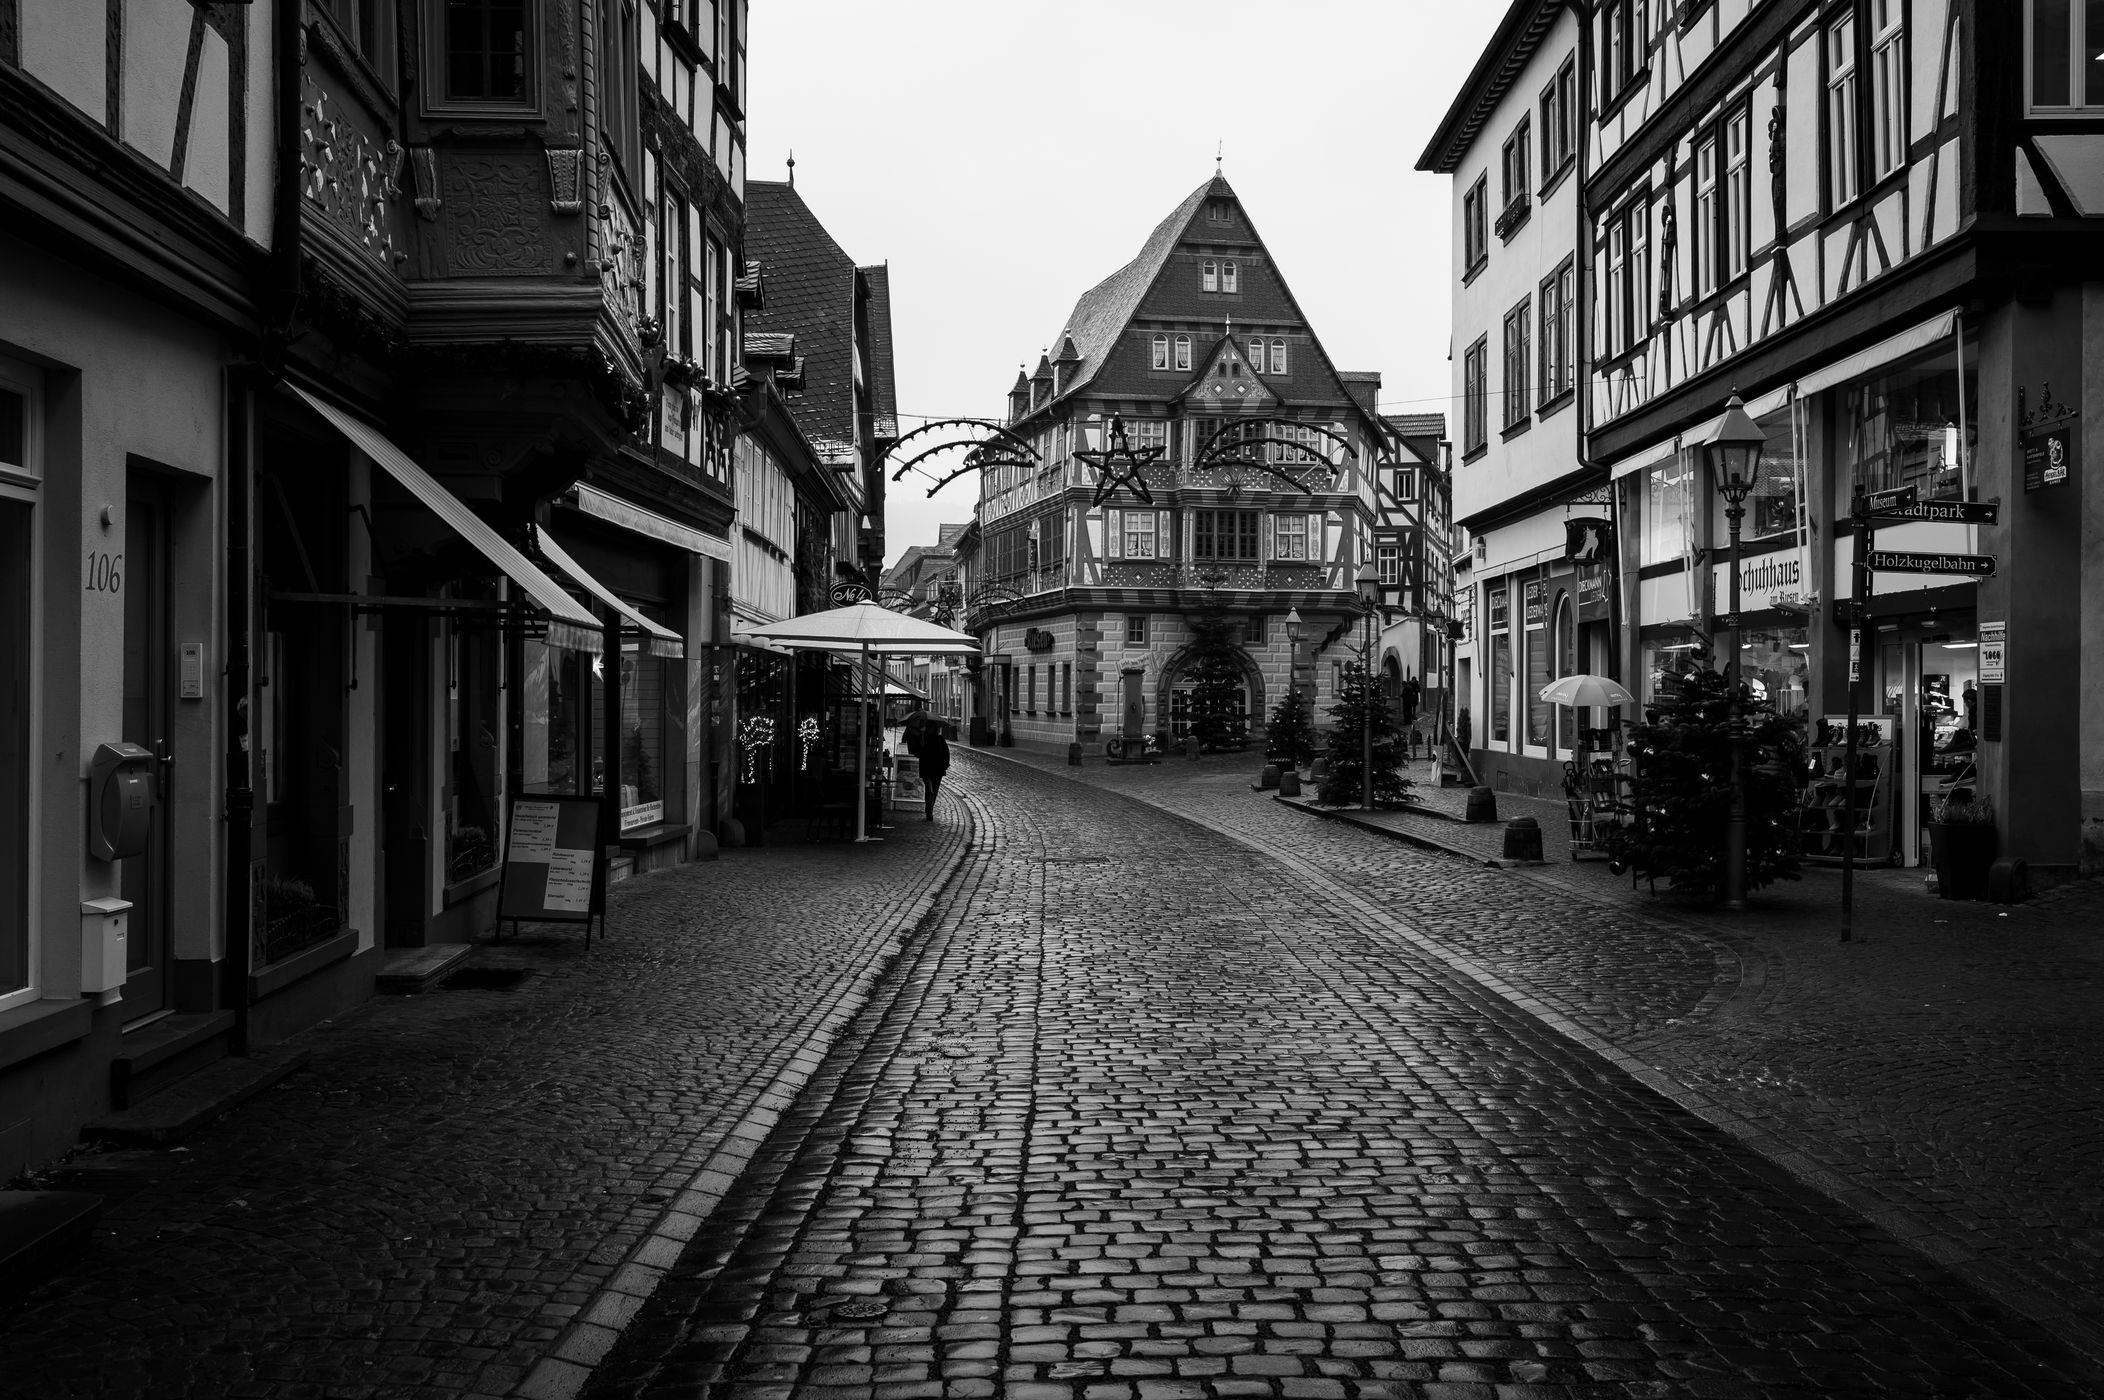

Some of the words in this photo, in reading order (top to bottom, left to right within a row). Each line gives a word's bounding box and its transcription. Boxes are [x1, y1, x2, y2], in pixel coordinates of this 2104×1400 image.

[1869, 495, 1897, 511] Museum
[1890, 502, 1965, 520] adtpark
[85, 551, 122, 593] 106
[1874, 554, 1976, 573] Holzkugelbahn
[1579, 576, 1602, 593] DIECKMANN
[1738, 556, 1800, 598] chuhhaus
[1779, 591, 1799, 604] Riesen
[1980, 631, 2006, 642] Nachhilfe
